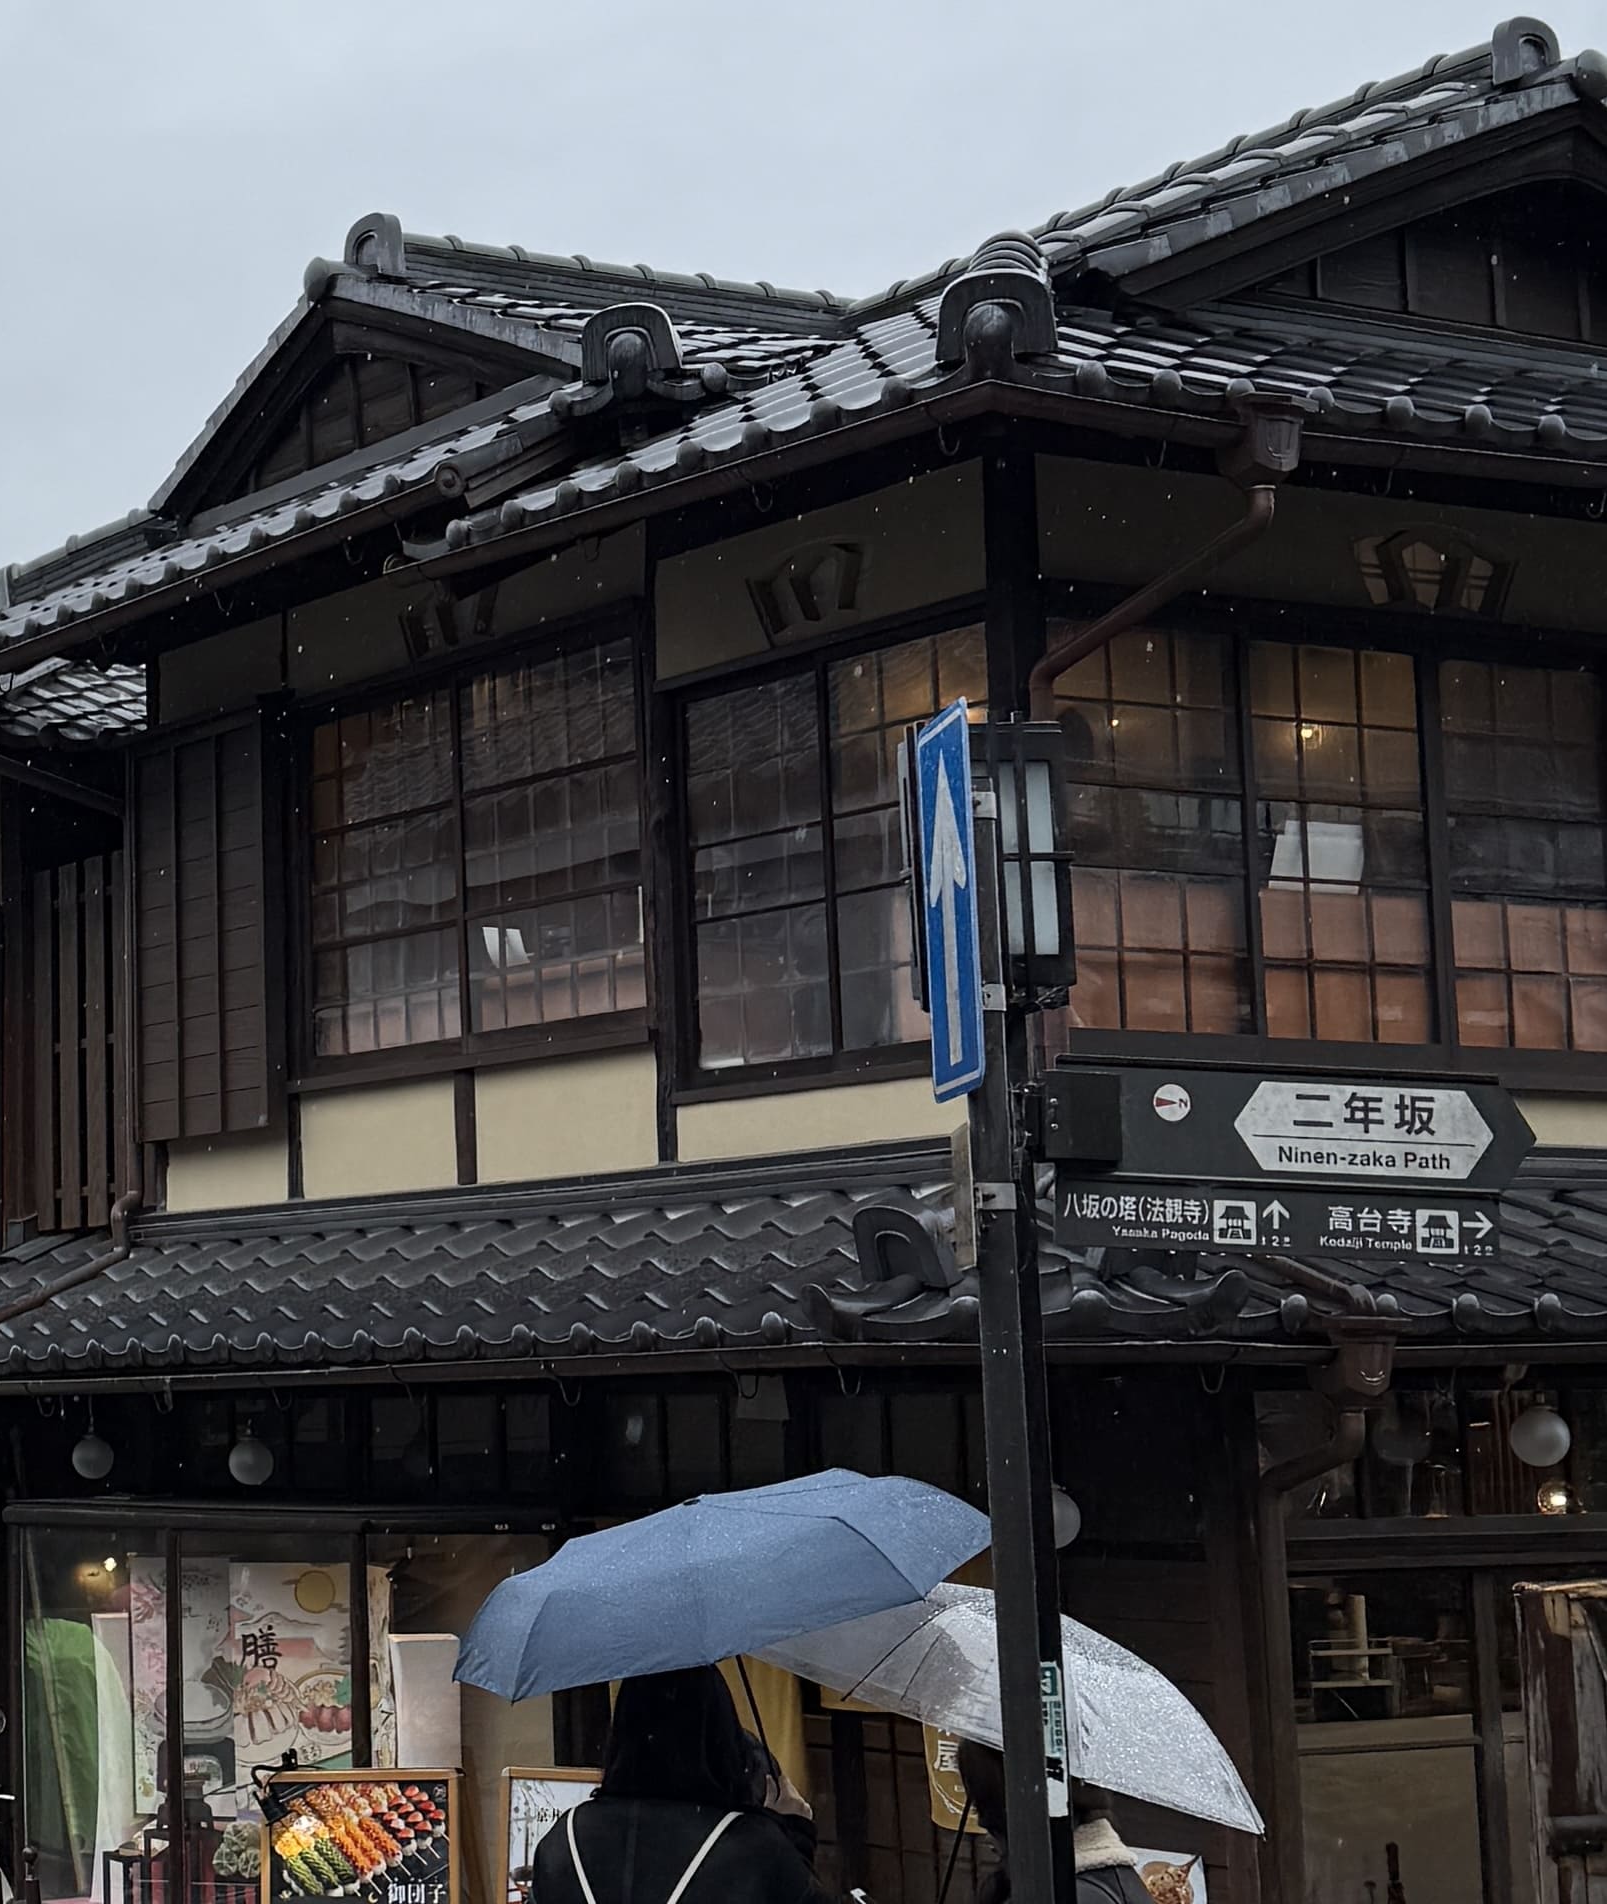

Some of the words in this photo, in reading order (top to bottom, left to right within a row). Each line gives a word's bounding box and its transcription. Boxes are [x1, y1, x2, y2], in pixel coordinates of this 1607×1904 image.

[1292, 1091, 1436, 1137] 二年坂
[1277, 1144, 1397, 1169] Ninen-zaka
[1403, 1151, 1451, 1171] Path
[1327, 1205, 1413, 1235] 高台寺
[1160, 1227, 1211, 1242] Pagoda
[1364, 1237, 1413, 1252] Temple
